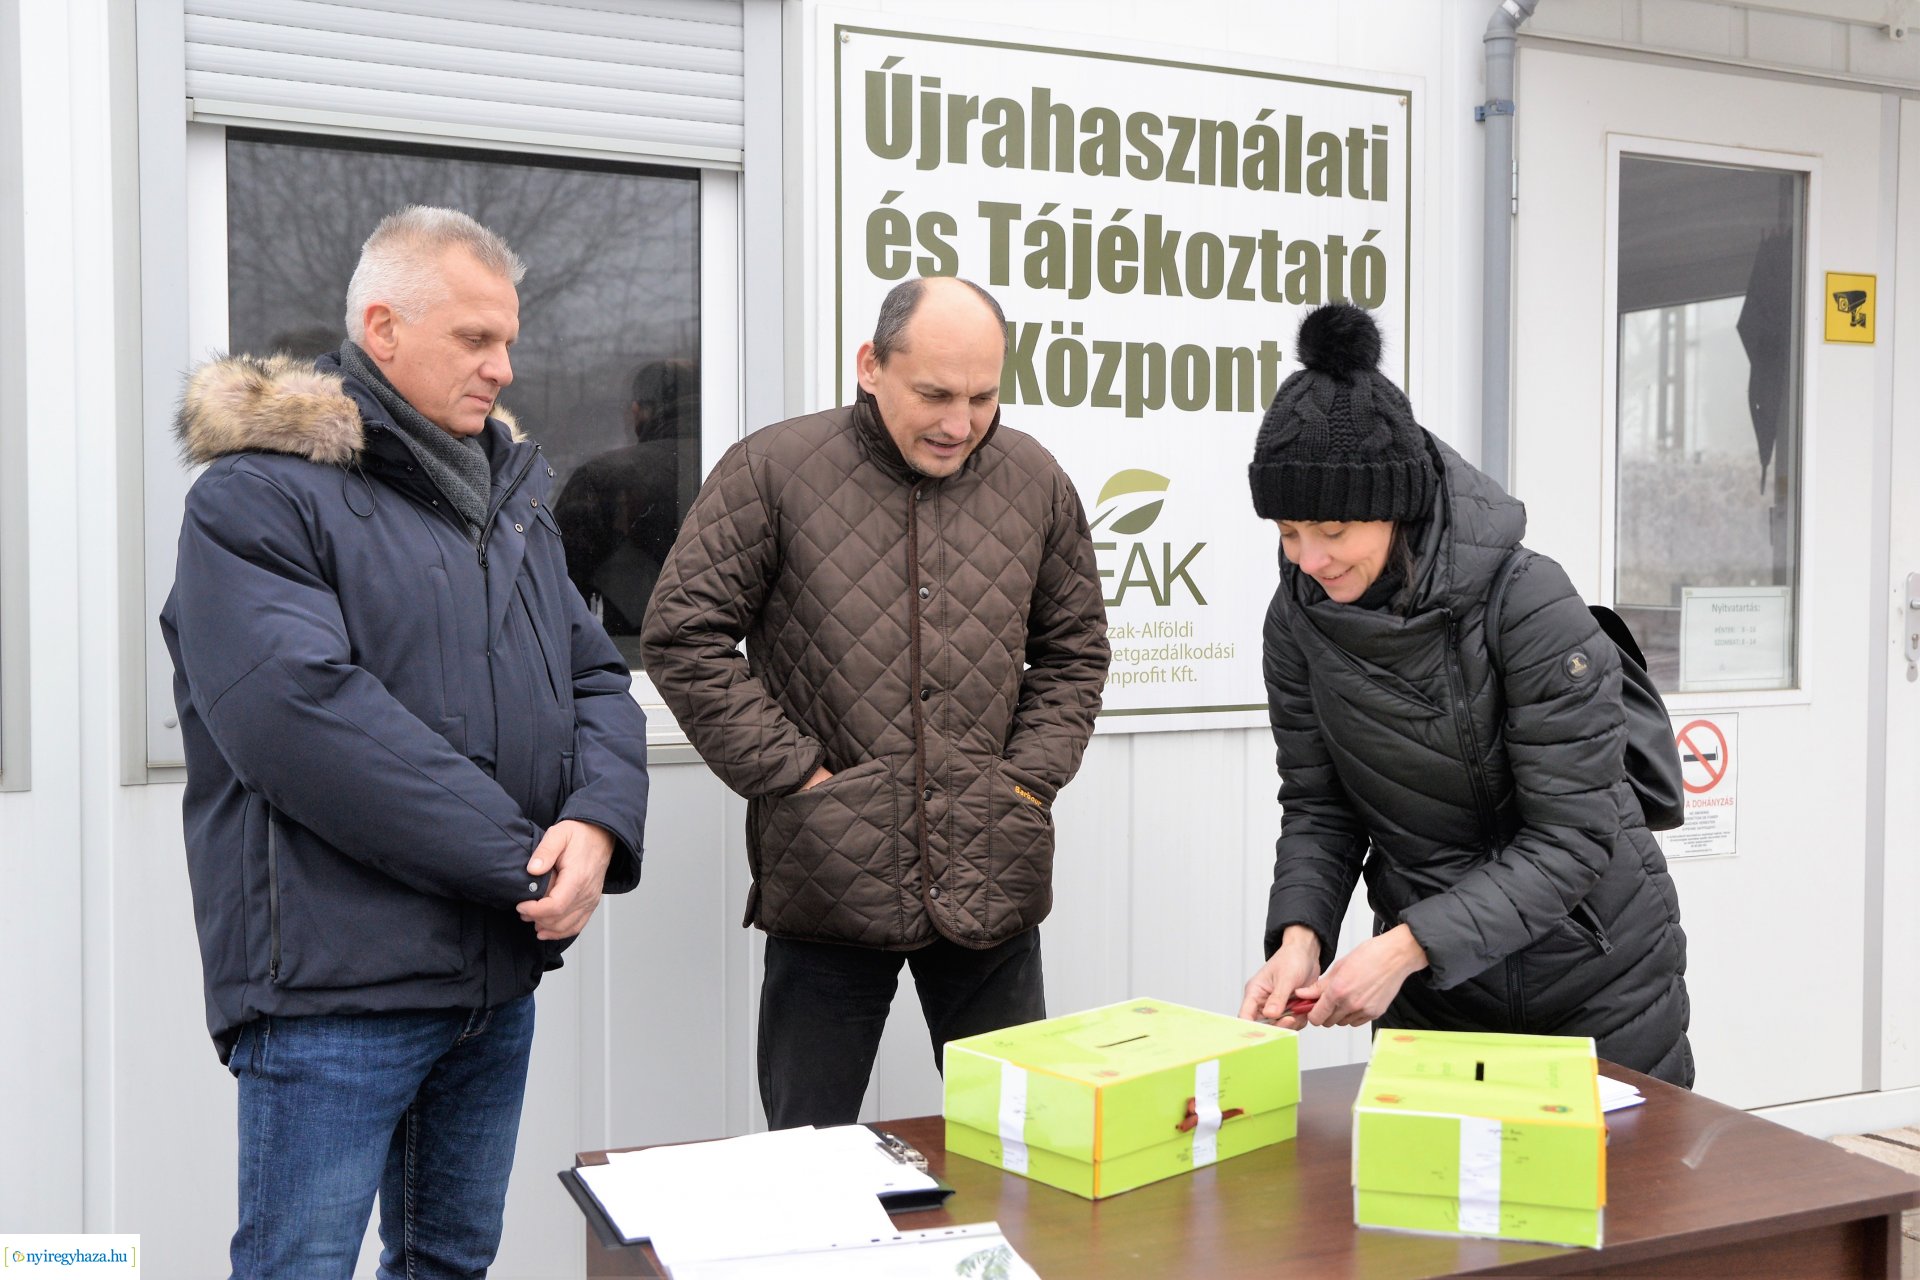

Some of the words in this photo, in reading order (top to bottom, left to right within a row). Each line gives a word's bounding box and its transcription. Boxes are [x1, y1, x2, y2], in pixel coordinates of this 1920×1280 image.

[865, 56, 1389, 202] Újrahasználati
[866, 190, 959, 281] és
[978, 200, 1387, 310] Tájékoztató
[999, 320, 1282, 418] Központ
[1711, 602, 1761, 614] Nyitvatartás:
[1172, 666, 1198, 683] Kft.
[1692, 796, 1735, 808] DOHÁNYZÁS
